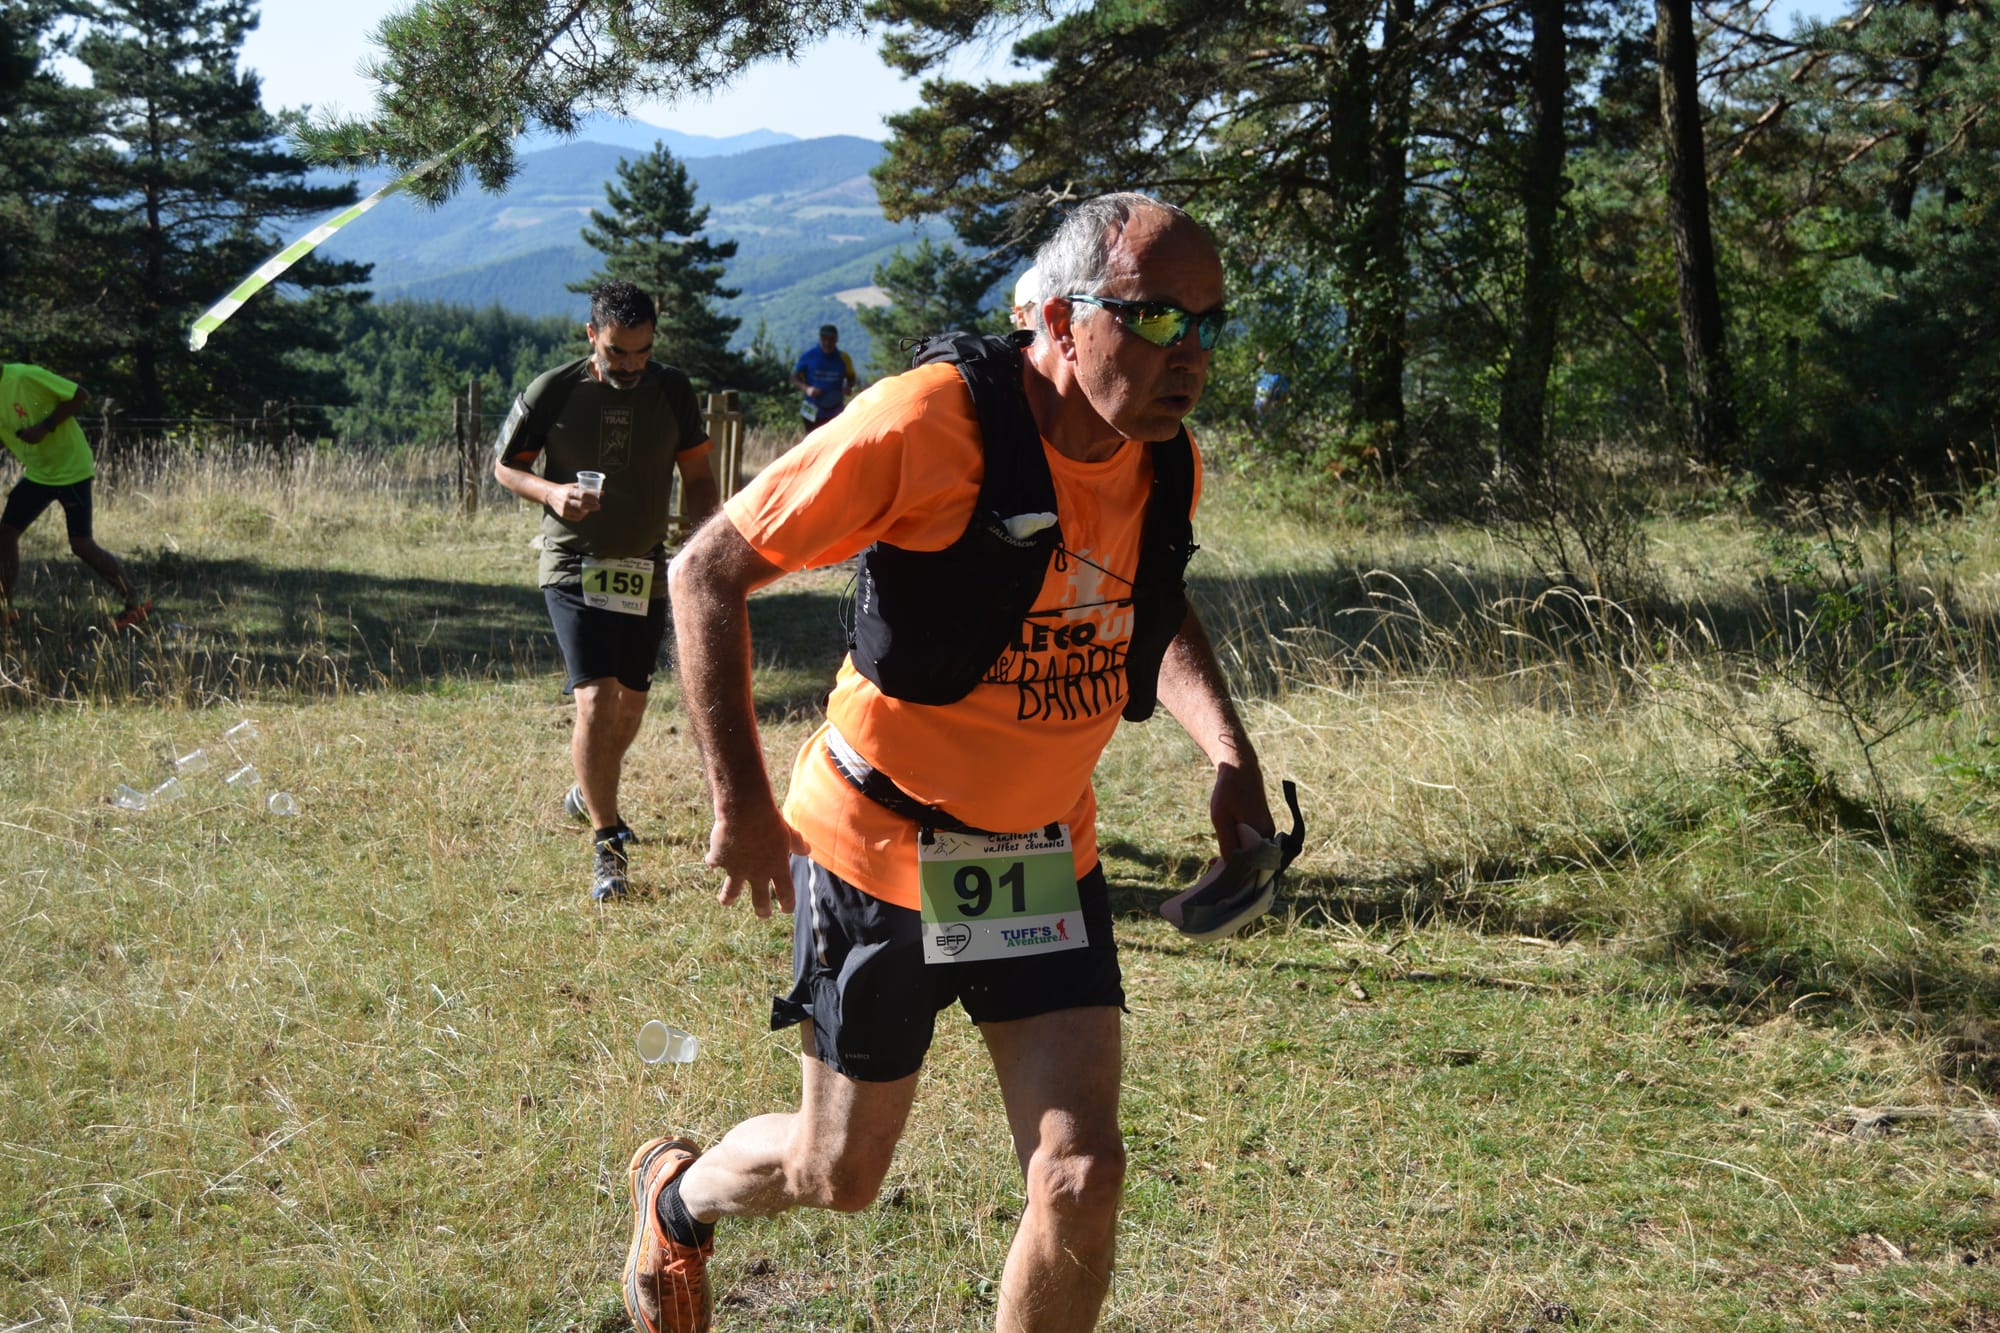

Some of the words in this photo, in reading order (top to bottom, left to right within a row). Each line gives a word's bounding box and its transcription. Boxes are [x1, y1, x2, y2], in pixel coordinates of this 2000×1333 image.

[594, 569, 644, 596] 159
[953, 861, 1026, 917] 91
[936, 934, 967, 946] BFP
[1000, 925, 1052, 941] TUFF'S
[1006, 934, 1058, 948] Aventure
